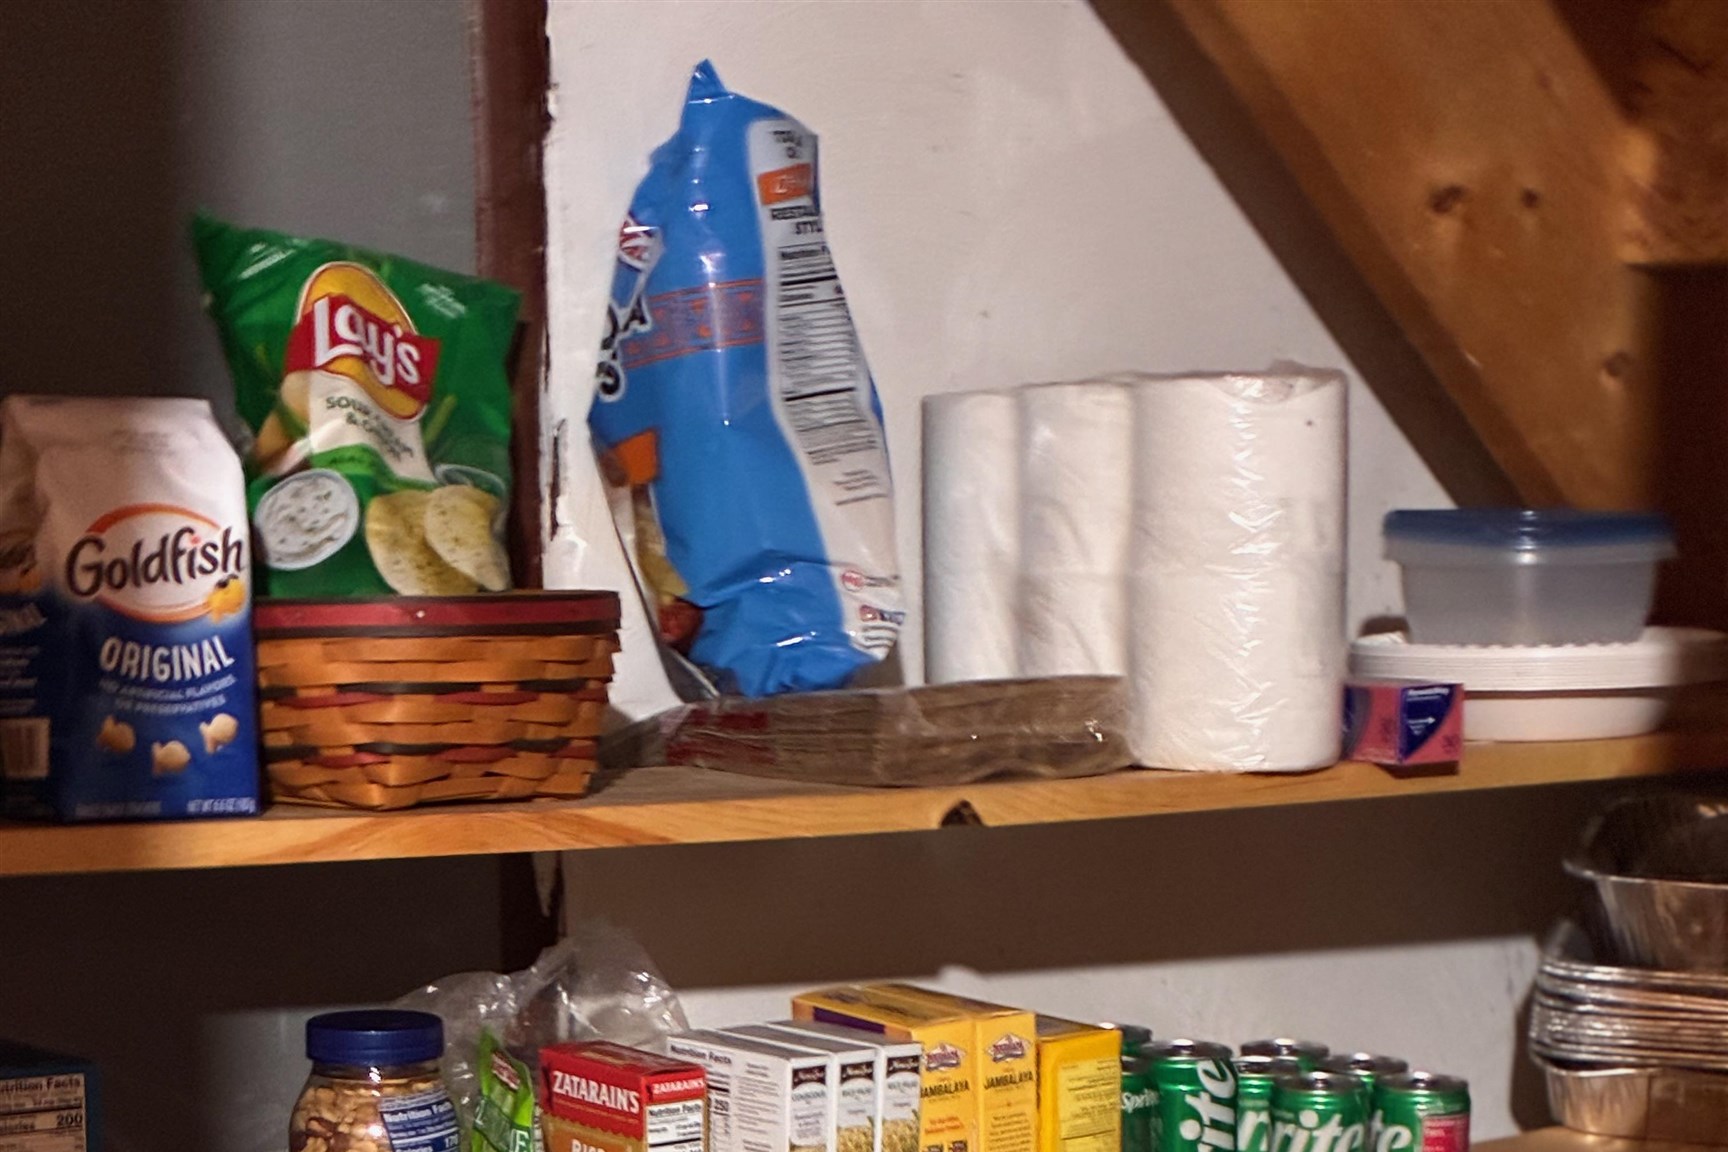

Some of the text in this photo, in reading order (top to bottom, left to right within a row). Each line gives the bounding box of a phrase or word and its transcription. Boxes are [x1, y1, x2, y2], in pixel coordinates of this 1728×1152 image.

[313, 297, 421, 387] Lay's
[66, 526, 244, 598] Goldfish
[100, 635, 235, 682] ORIGINAL
[552, 1071, 640, 1115] ZATARAIN'S
[57, 1111, 83, 1129] 200
